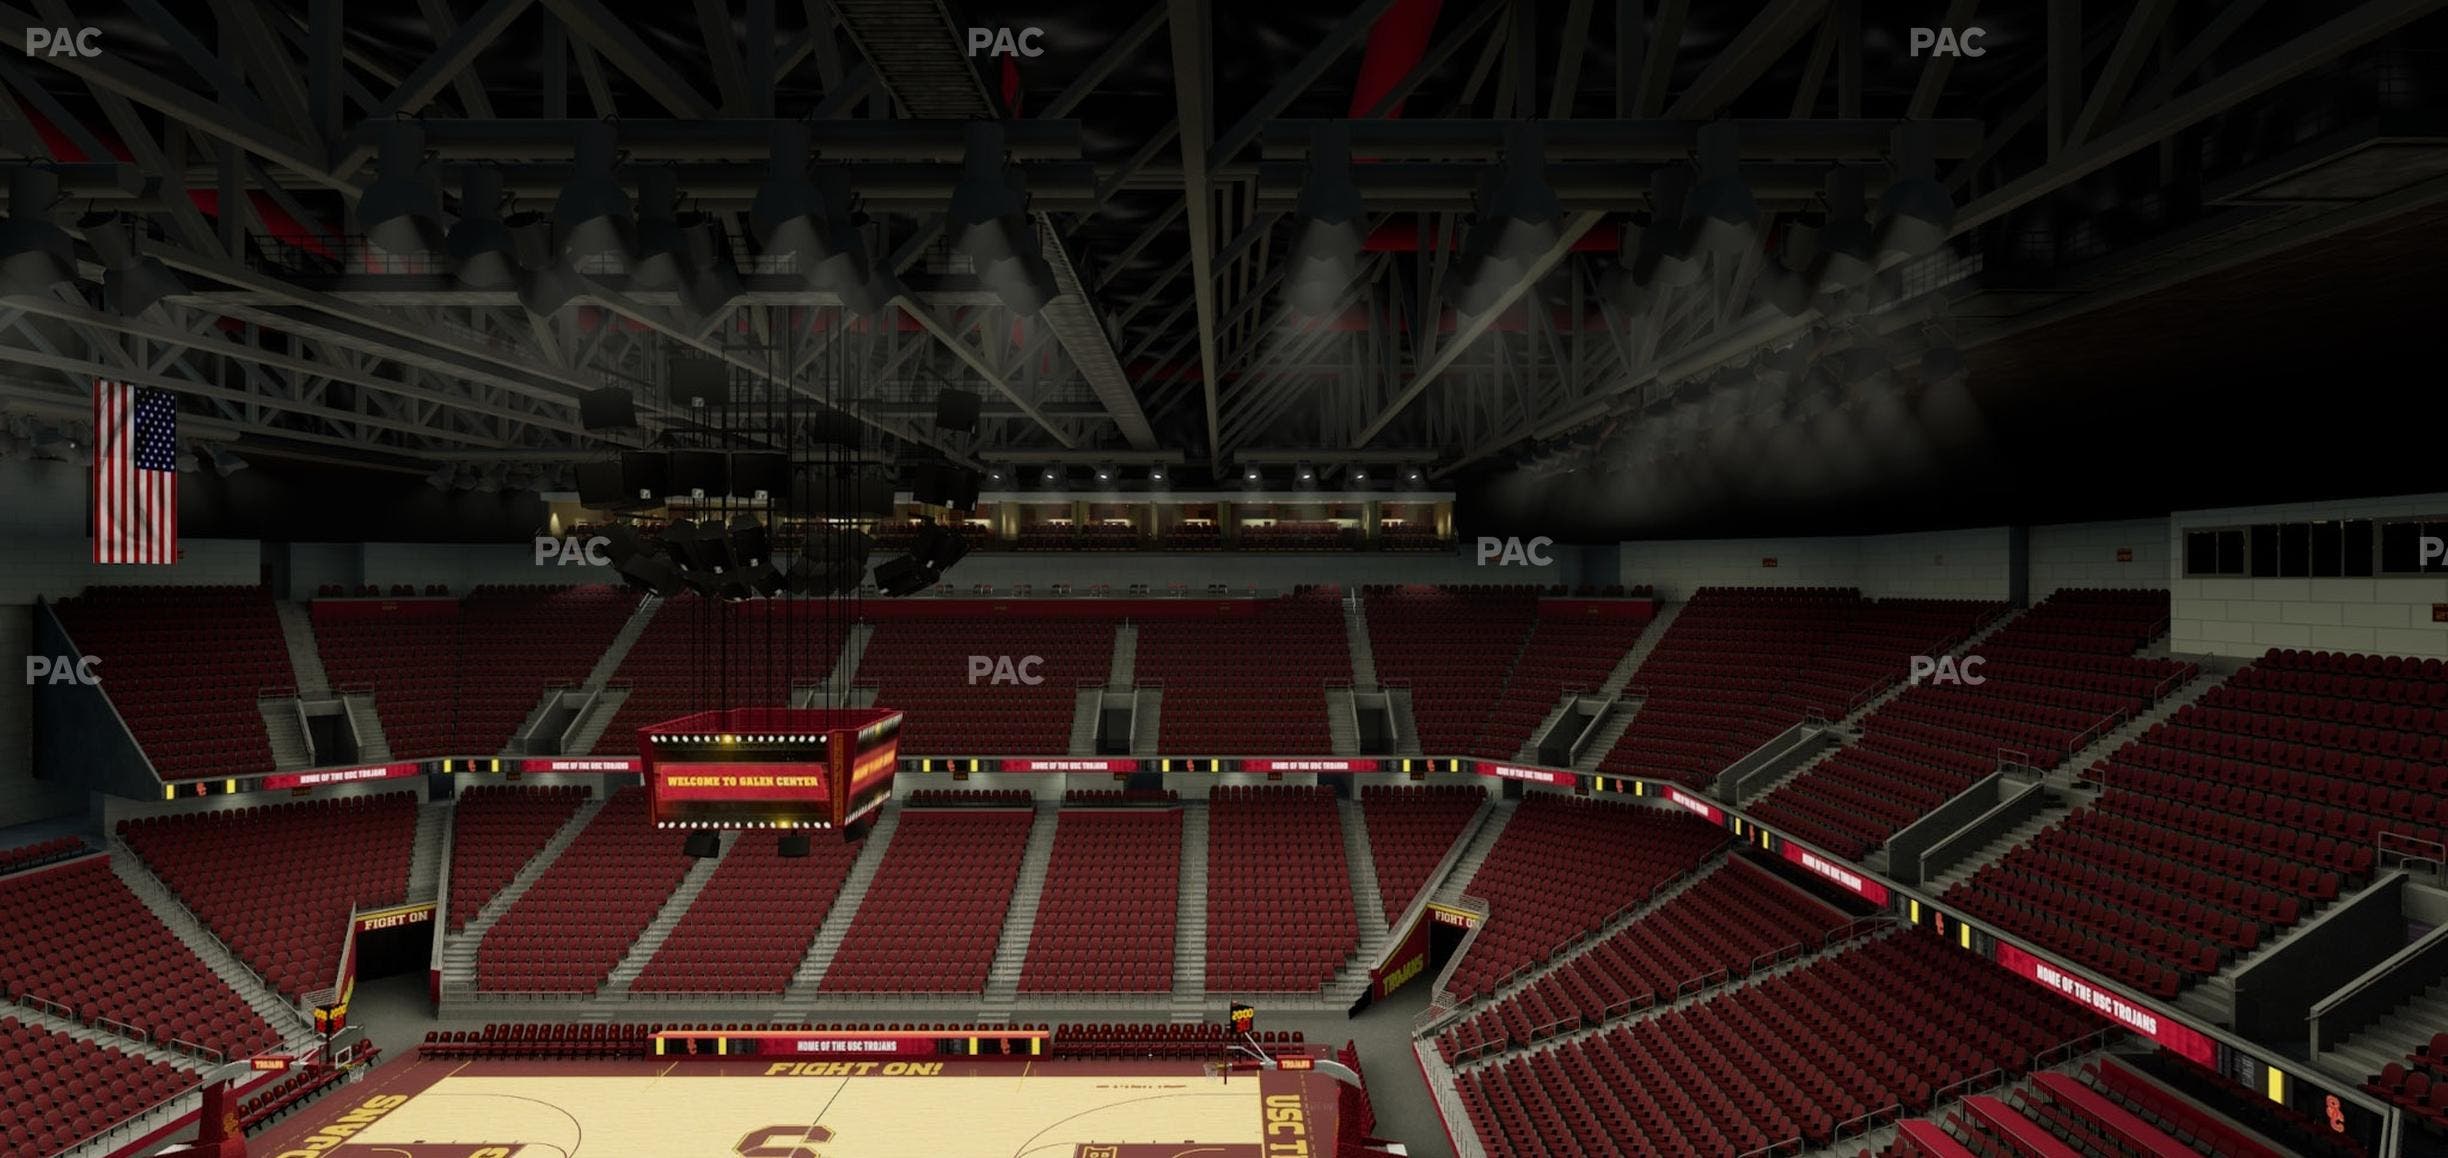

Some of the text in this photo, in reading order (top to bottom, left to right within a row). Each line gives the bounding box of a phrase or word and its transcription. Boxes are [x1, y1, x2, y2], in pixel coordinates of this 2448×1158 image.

[667, 776, 818, 786] WELCOME TO GALEN CENTER
[364, 911, 428, 930] FIGHT ON
[1435, 911, 1464, 926] FIGHT
[2036, 964, 2157, 1035] HOME OF THE USC TROJANS
[797, 1041, 897, 1051] HOME OF THE USC TROJANS
[764, 1062, 944, 1076] FIGHT ON!
[1266, 1095, 1309, 1158] USC T
